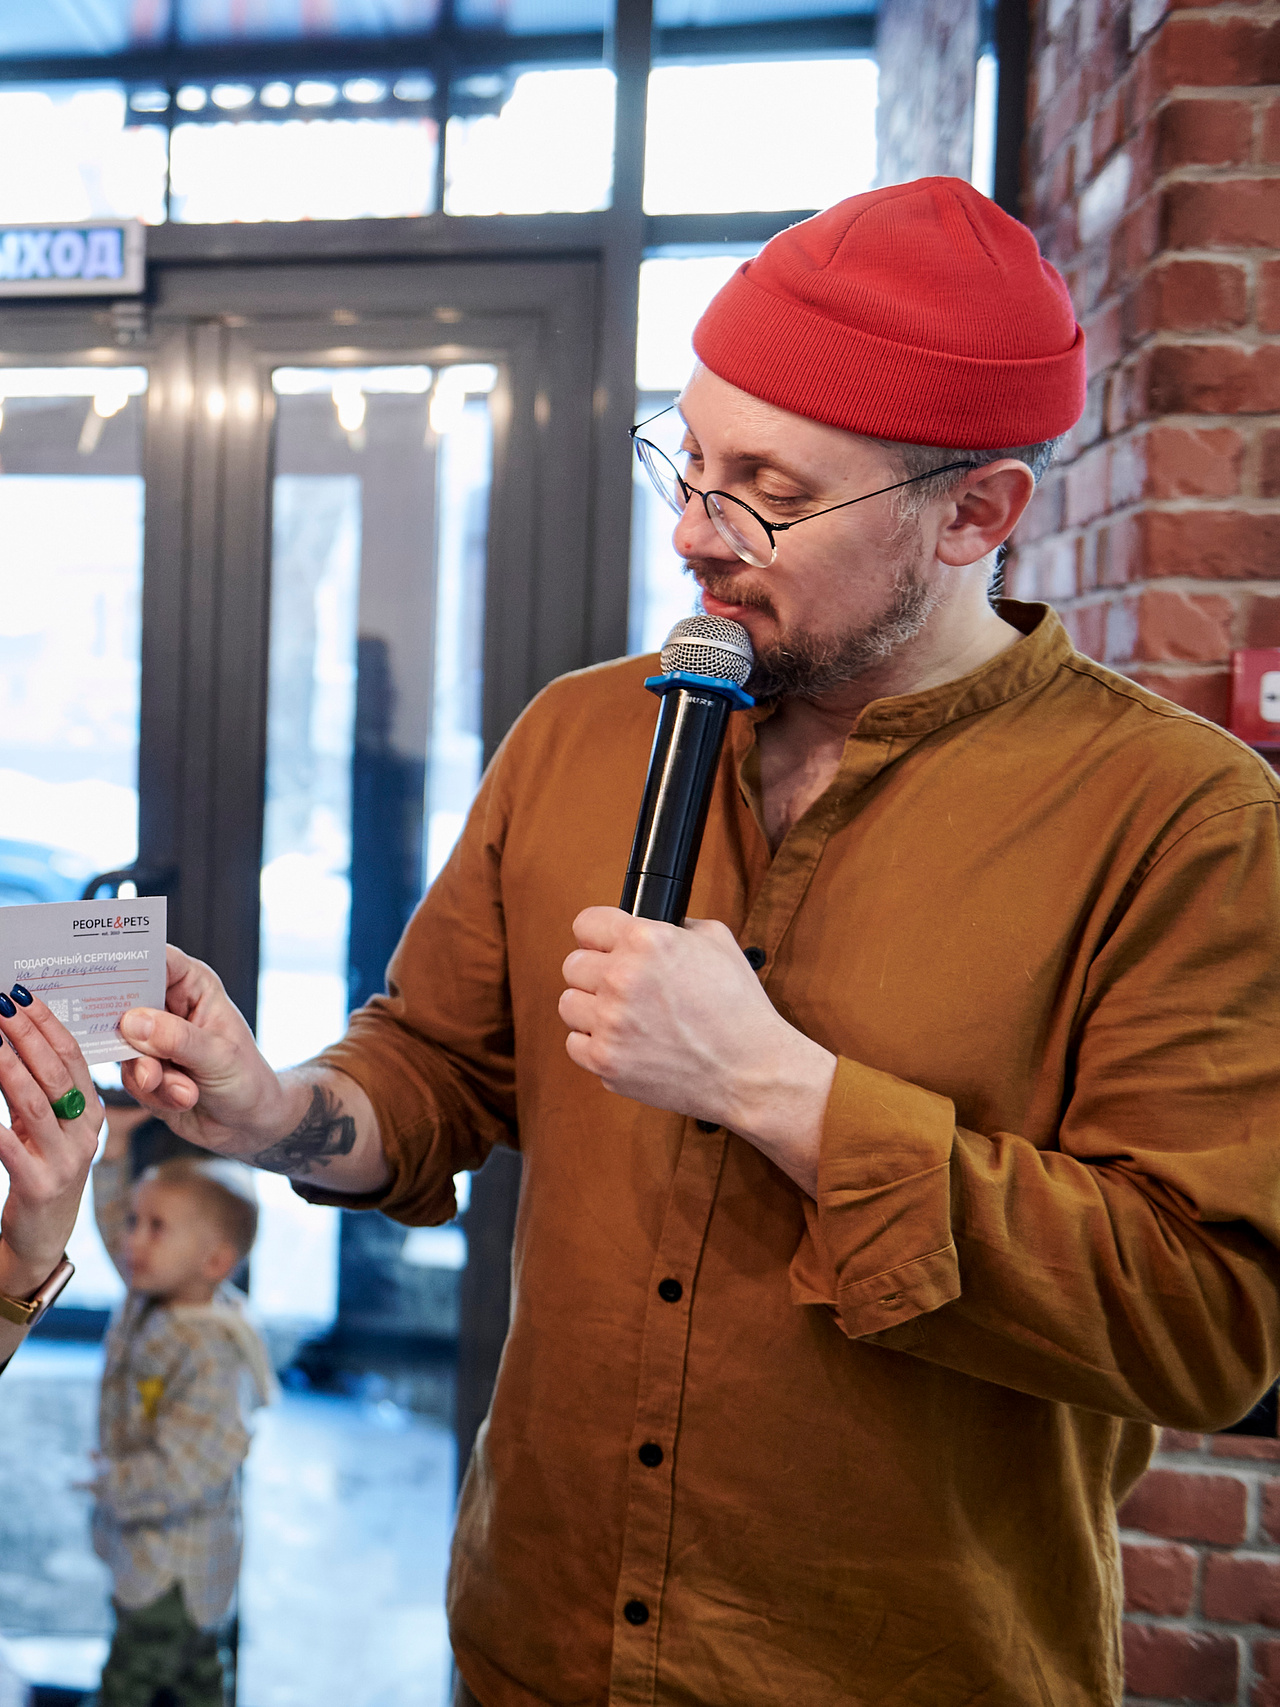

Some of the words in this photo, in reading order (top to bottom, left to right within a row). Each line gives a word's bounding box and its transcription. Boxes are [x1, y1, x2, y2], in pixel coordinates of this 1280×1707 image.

[683, 696, 714, 706] HURE
[73, 915, 150, 930] PEOPLE&PETS
[14, 953, 82, 970] ПОДАРОЧНЫЙ
[83, 950, 150, 964] СЕРТИФИКАТ
